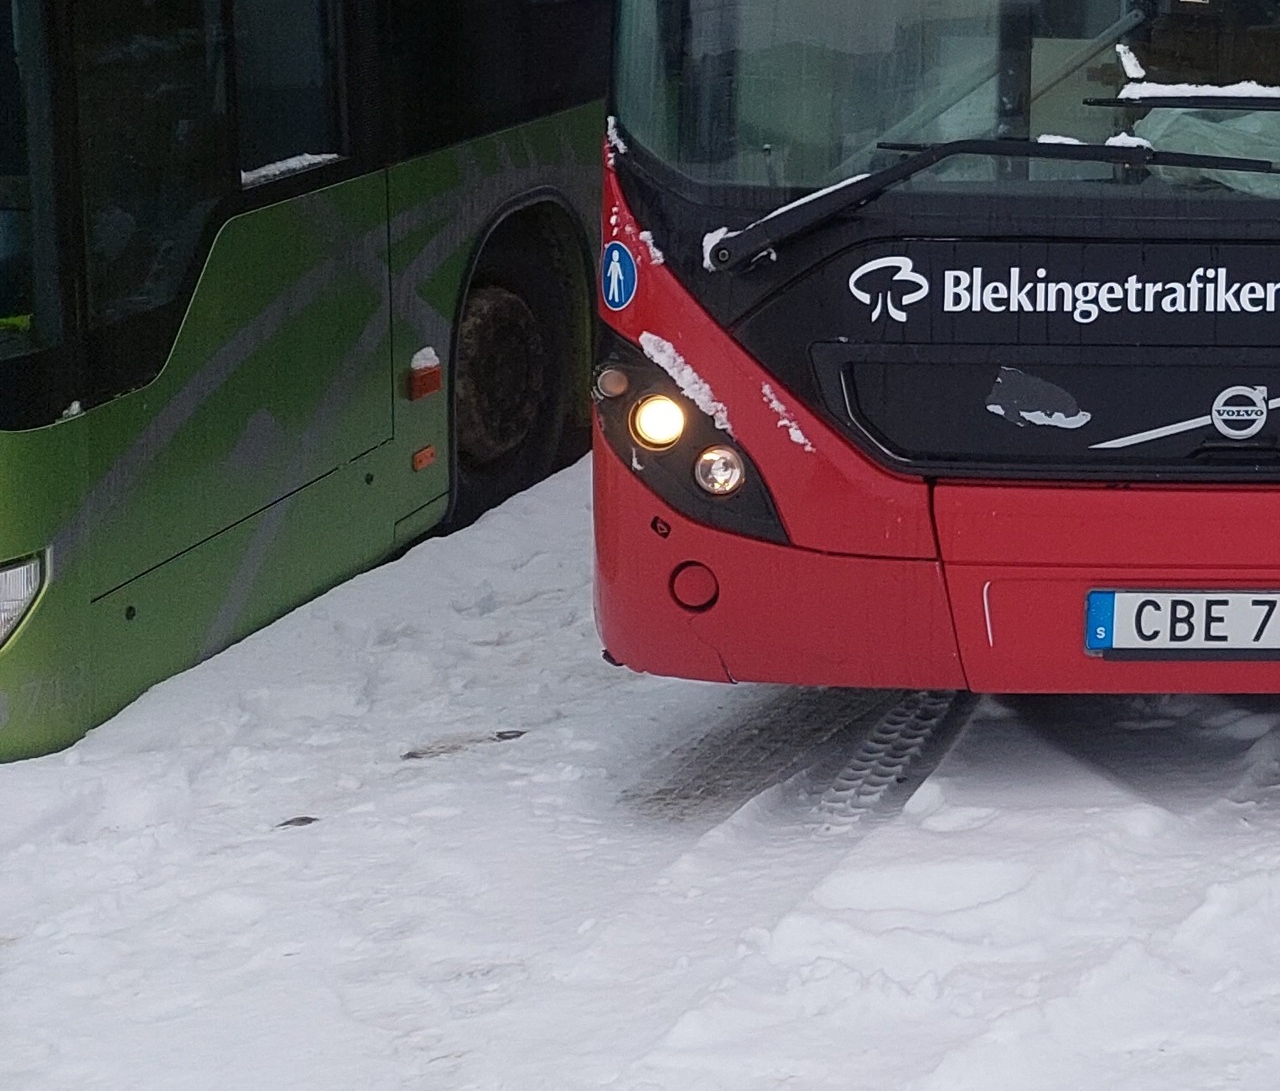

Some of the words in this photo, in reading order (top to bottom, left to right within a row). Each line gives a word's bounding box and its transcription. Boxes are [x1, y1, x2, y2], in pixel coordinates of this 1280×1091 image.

[1214, 408, 1265, 418] VOLVO
[1095, 626, 1106, 639] S
[1134, 598, 1230, 642] CBE
